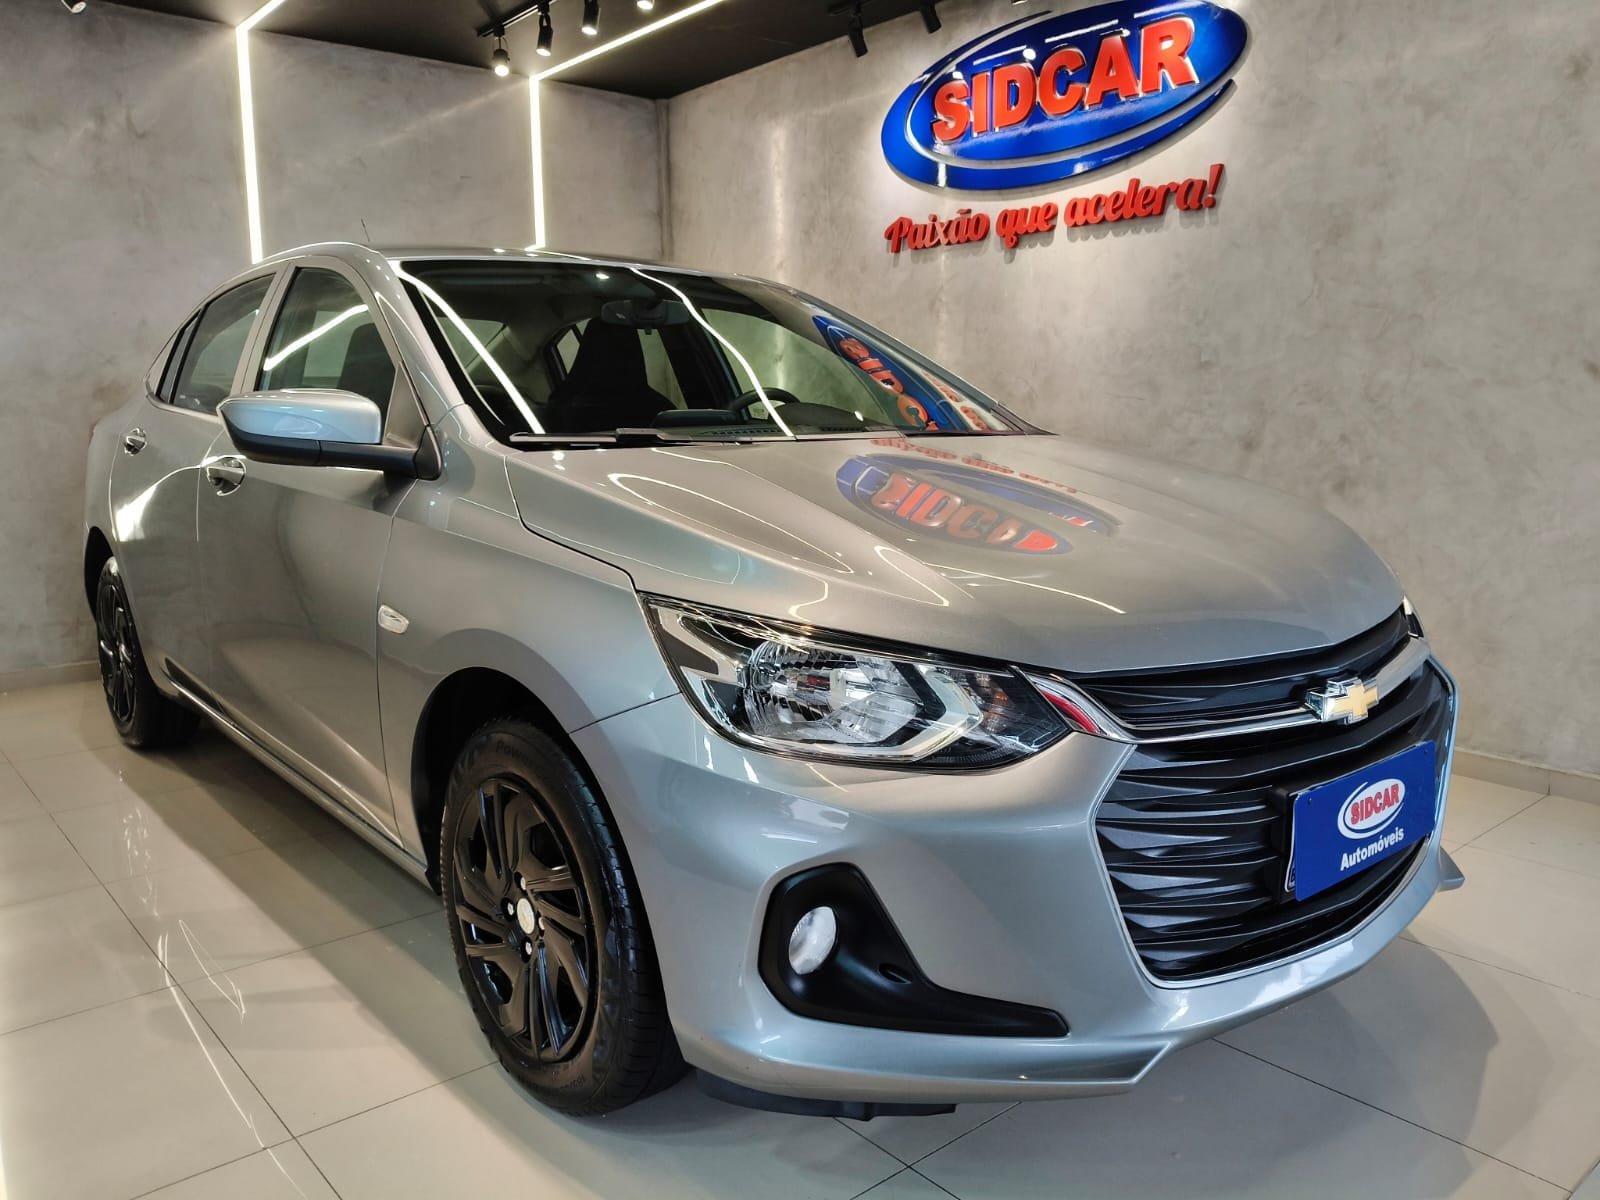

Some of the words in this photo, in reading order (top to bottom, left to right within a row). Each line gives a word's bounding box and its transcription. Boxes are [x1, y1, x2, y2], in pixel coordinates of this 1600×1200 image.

[931, 16, 1199, 145] SIDCAR
[884, 207, 990, 254] Paixão
[996, 199, 1058, 249] que
[1064, 163, 1225, 228] acelera!
[1350, 783, 1400, 825] SIDCAR
[1340, 826, 1404, 871] Automóveis
